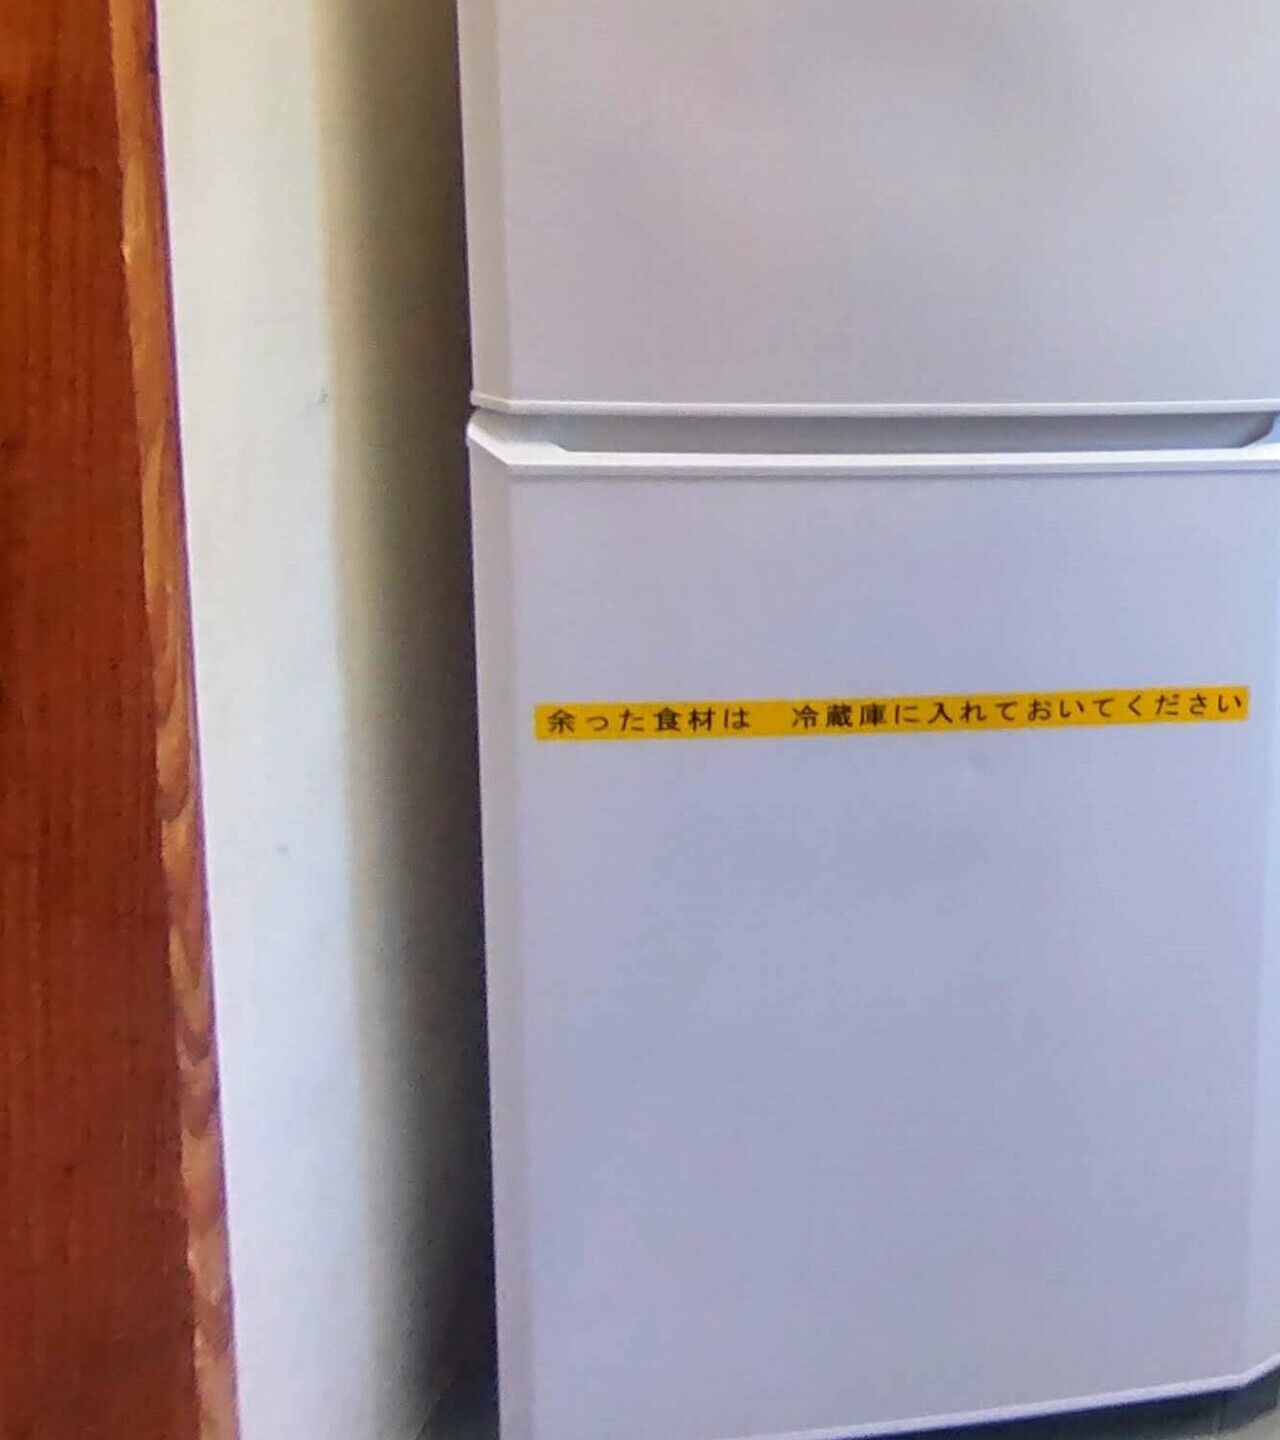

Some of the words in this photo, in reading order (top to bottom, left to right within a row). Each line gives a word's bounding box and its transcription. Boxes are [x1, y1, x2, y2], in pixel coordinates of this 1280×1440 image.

[546, 707, 751, 733] 余った食材は
[791, 692, 1242, 729] 冷蔵庫に入れておいてください
